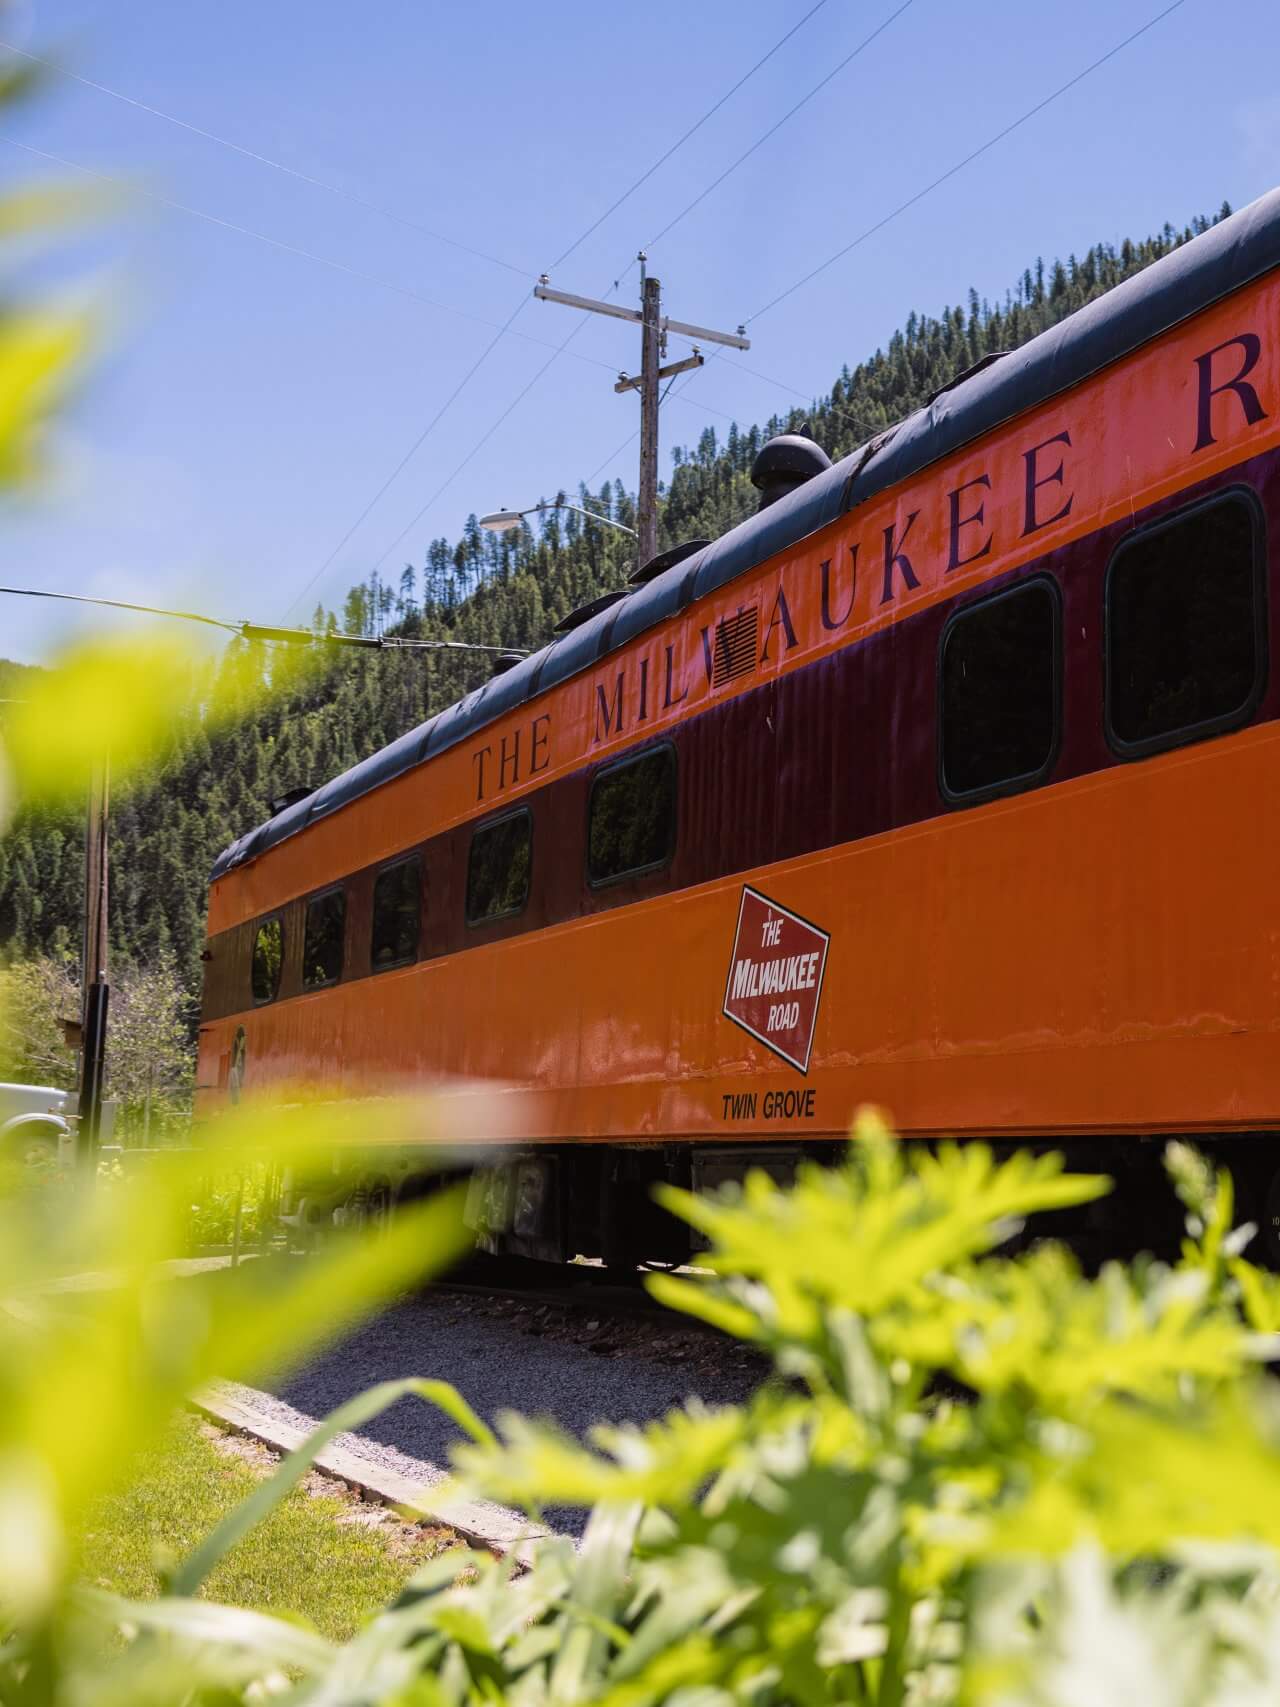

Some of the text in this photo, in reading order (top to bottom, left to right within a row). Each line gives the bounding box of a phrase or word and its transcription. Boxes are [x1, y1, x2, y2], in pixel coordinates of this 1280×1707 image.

[472, 714, 550, 800] THE
[593, 430, 1075, 743] MILWAUKEE
[761, 918, 784, 948] THE
[731, 952, 820, 1000] MILWAUKEE
[767, 1001, 800, 1032] ROAD
[722, 1089, 816, 1120] TWIN GROVE
